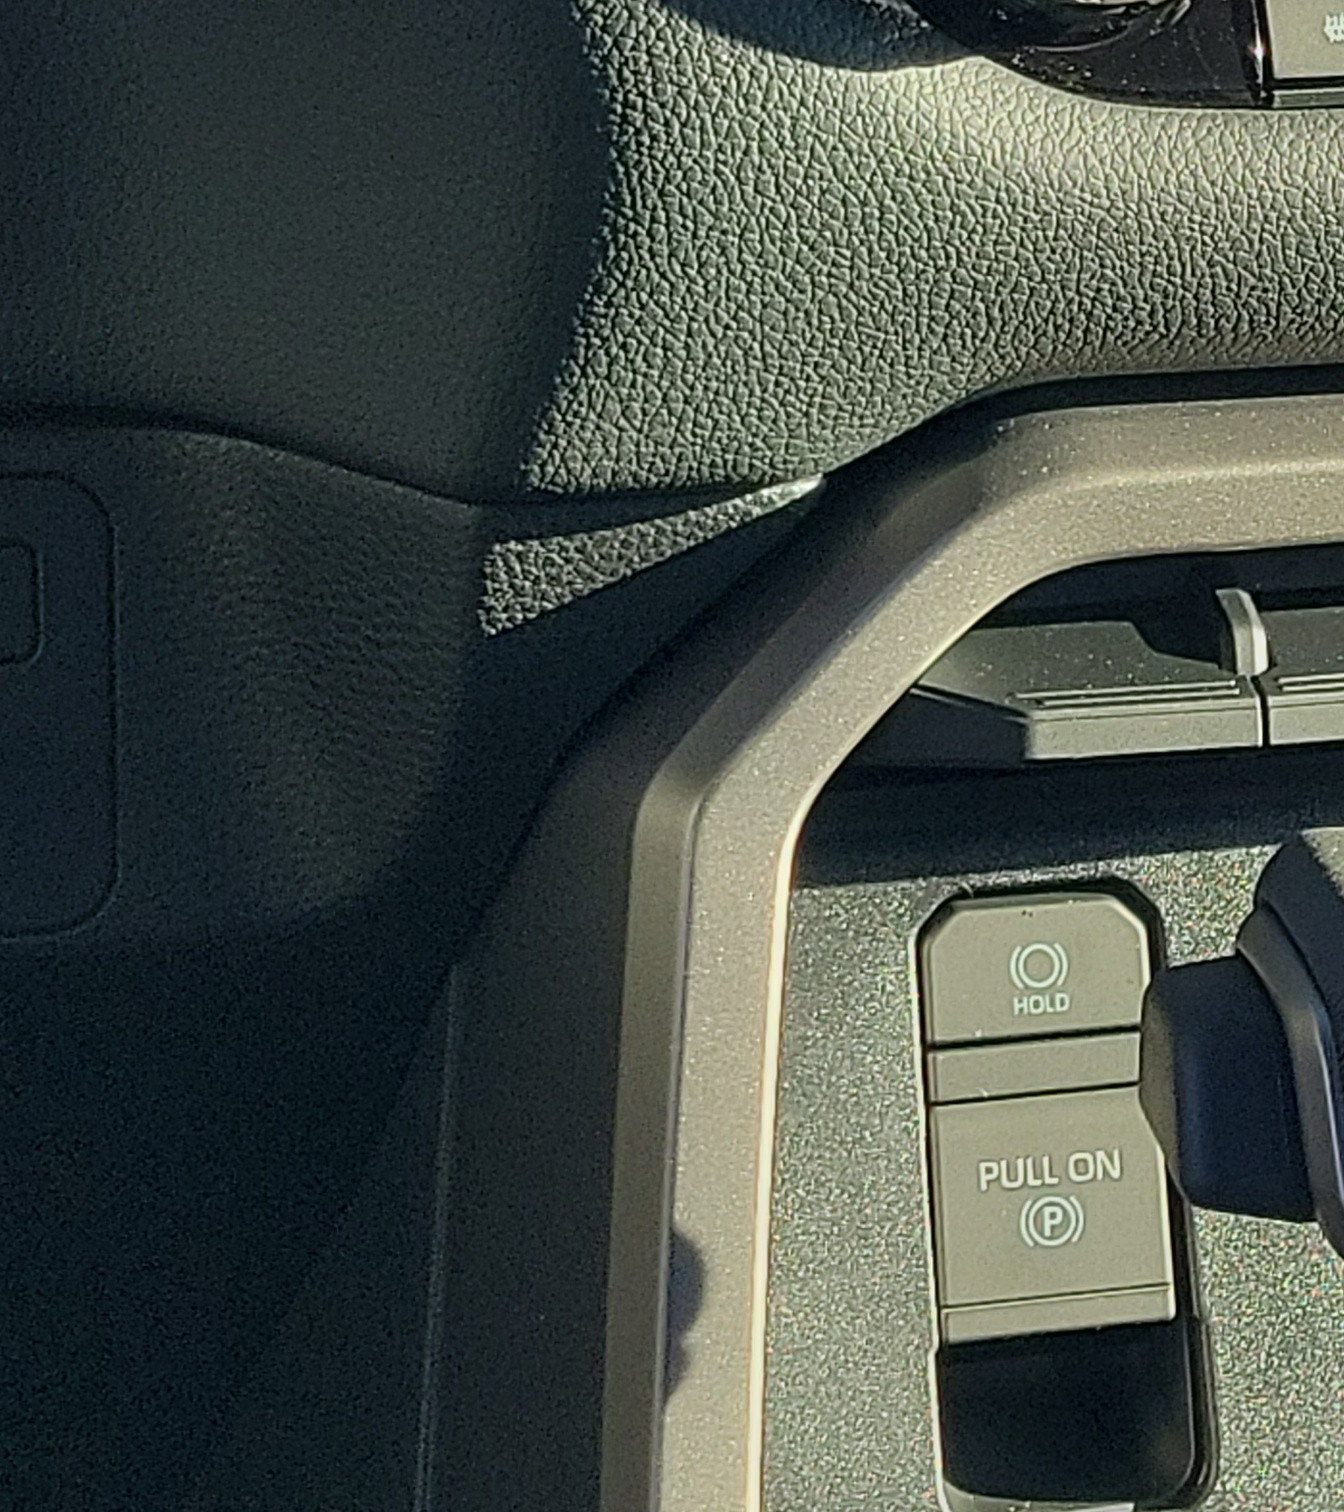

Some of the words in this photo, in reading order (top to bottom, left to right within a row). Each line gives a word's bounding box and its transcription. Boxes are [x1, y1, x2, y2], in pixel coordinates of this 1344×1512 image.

[1013, 992, 1071, 1016] HOLD
[978, 1154, 1060, 1192] PULL
[1067, 1148, 1122, 1184] ON
[1043, 1209, 1063, 1237] P
